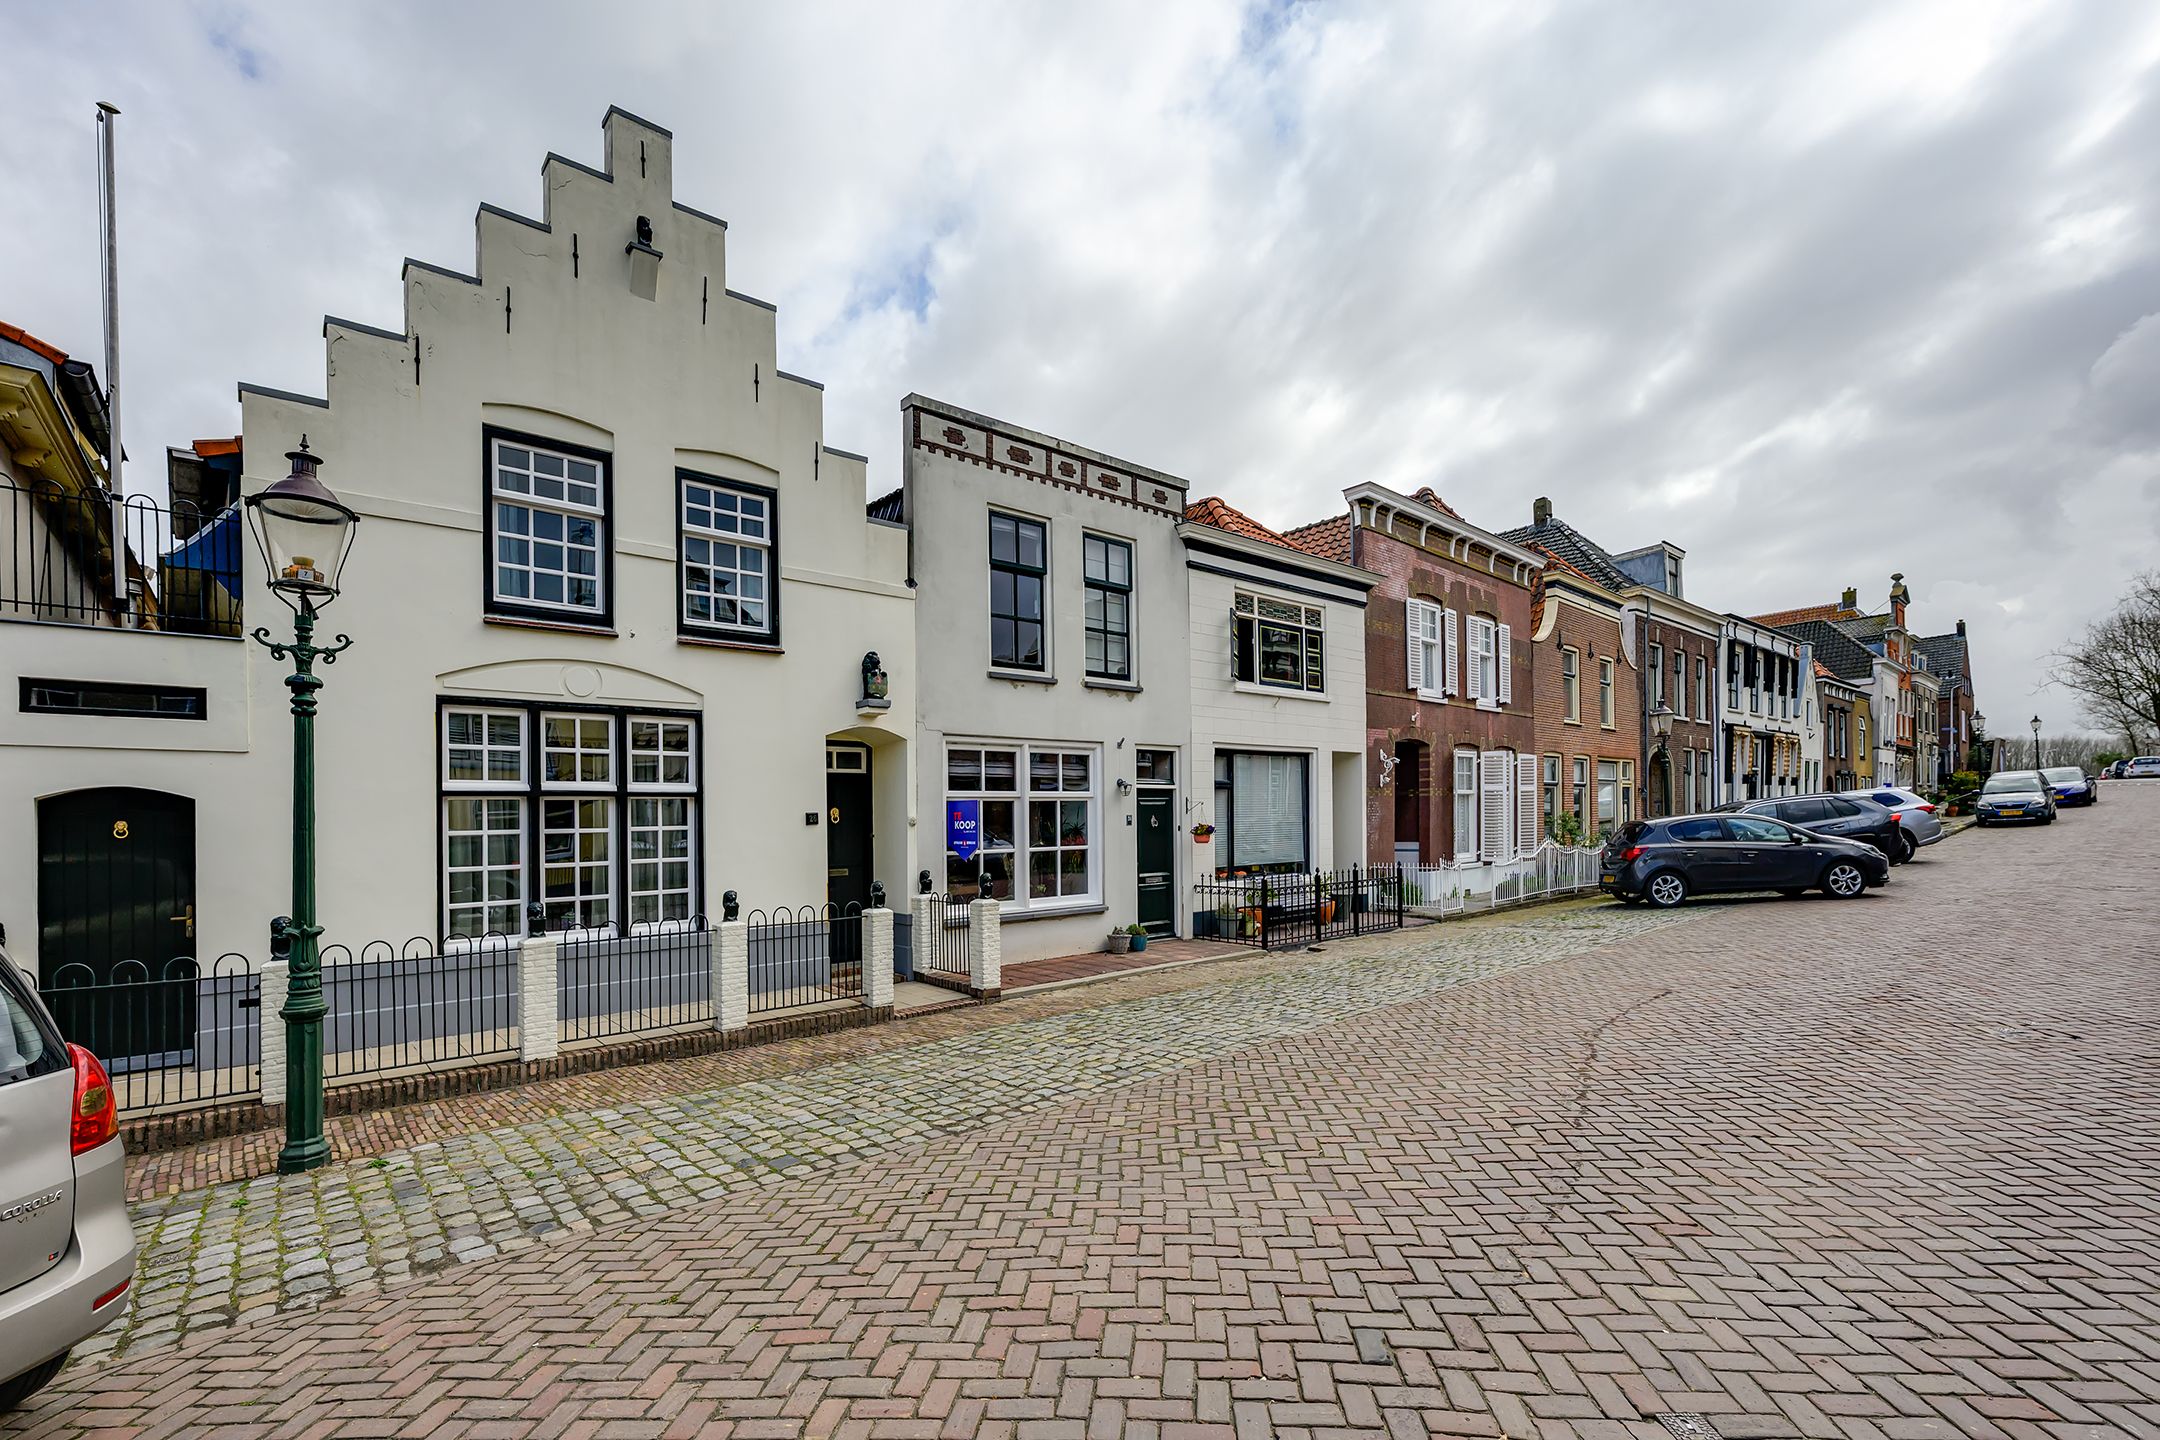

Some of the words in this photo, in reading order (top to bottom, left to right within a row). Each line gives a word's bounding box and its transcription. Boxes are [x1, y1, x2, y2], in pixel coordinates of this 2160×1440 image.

[953, 811, 961, 820] TE
[954, 820, 976, 830] KOOP
[1, 1189, 63, 1222] COROLLA
